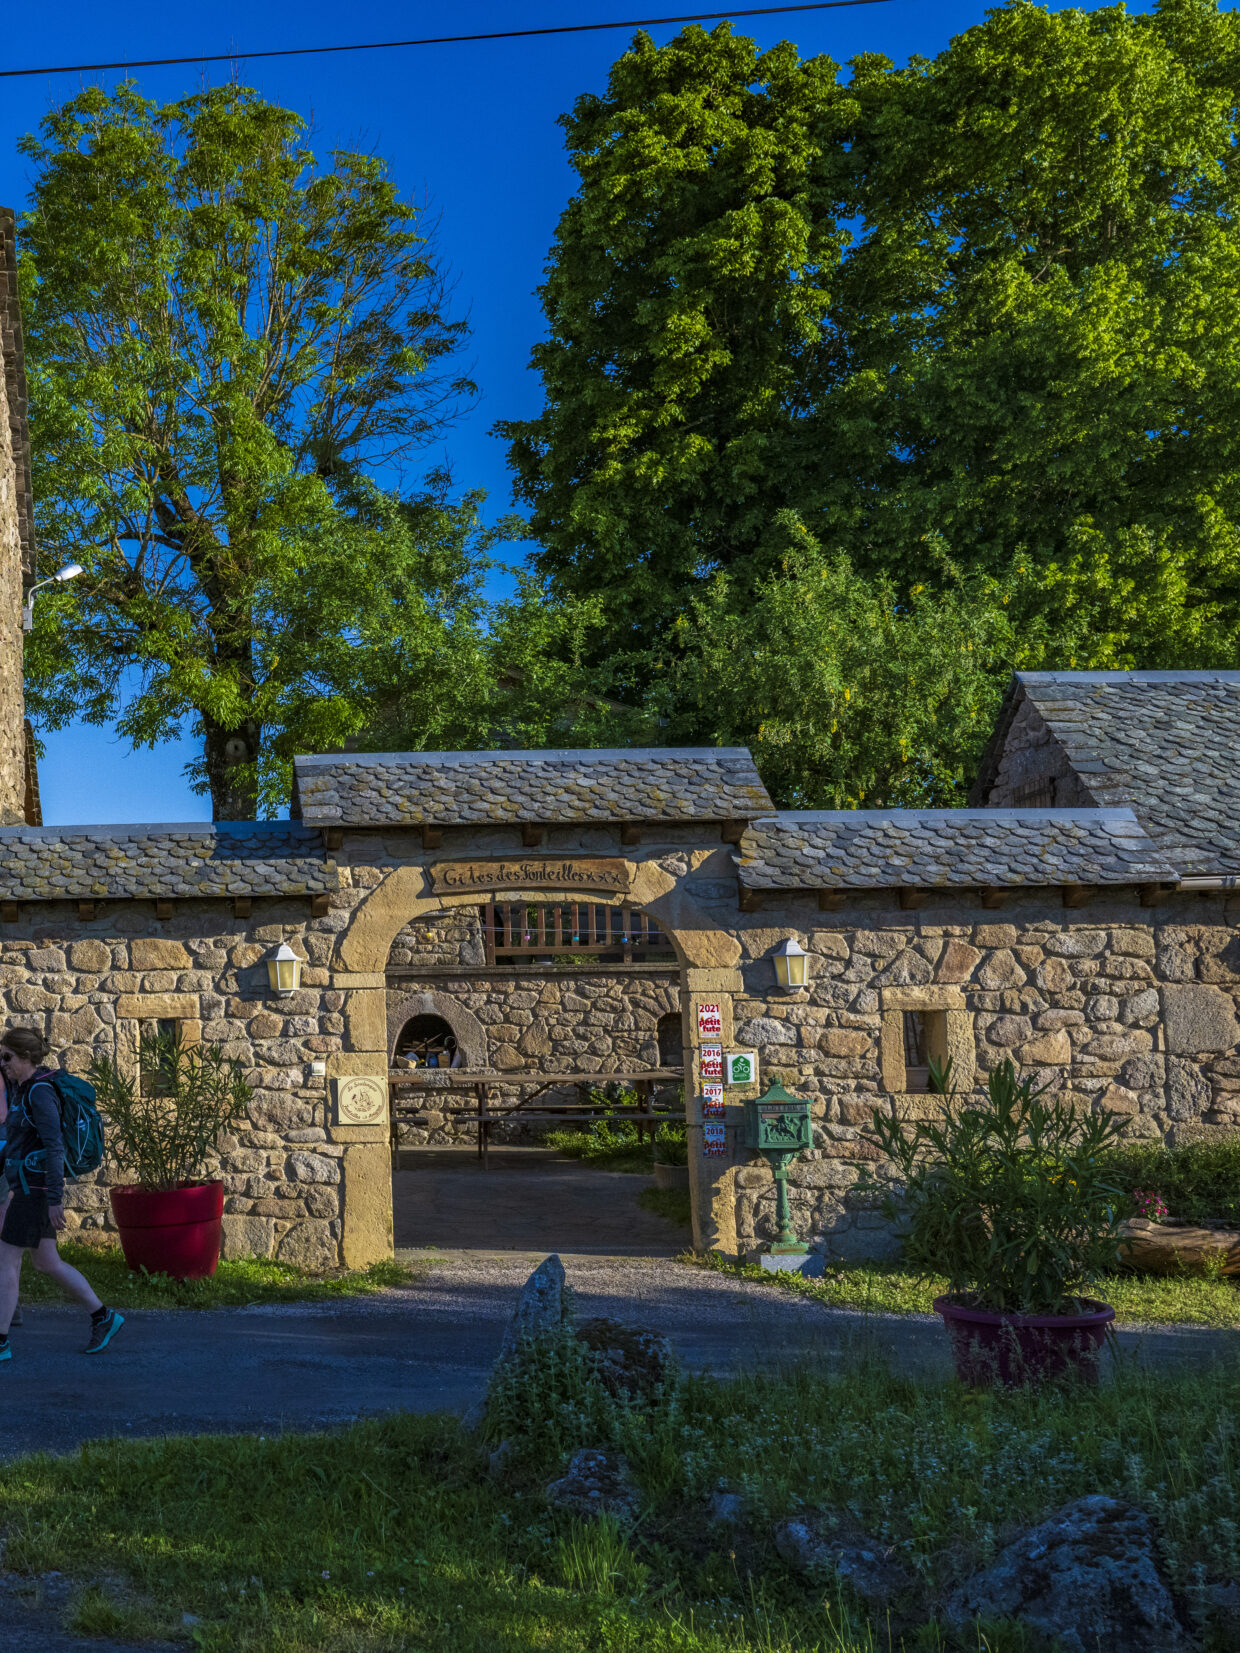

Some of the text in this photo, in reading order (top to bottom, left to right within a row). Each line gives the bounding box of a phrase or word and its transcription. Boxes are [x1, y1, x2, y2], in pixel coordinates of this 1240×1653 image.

[496, 864, 520, 881] des
[520, 863, 584, 882] Fonteilles
[699, 1004, 719, 1013] 2021
[699, 1018, 721, 1027] petit
[702, 1049, 721, 1057] 2016
[700, 1061, 723, 1070] petit
[704, 1088, 722, 1096] 2017
